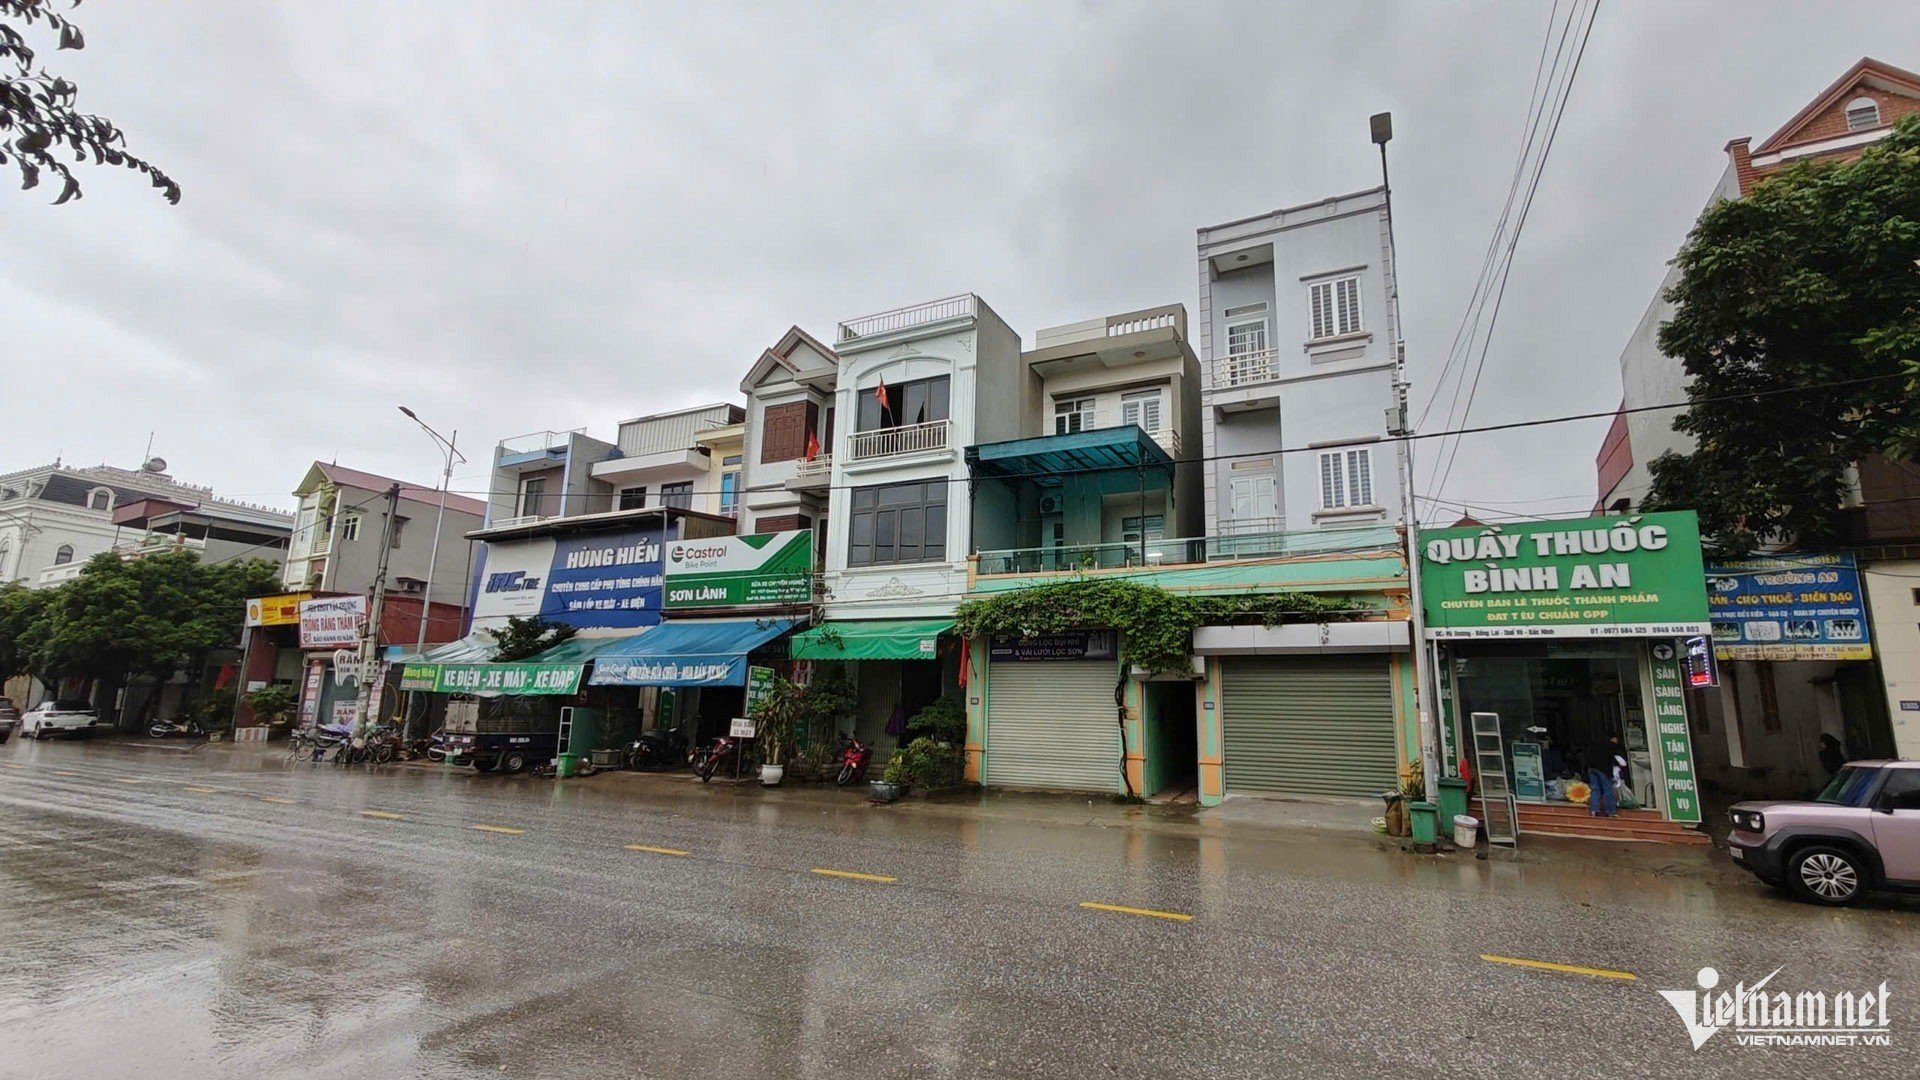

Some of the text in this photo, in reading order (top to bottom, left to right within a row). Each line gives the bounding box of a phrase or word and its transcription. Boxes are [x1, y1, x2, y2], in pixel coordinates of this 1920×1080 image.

[1531, 516, 1668, 556] THUỐC
[567, 537, 661, 569] HÙNG HIỂN
[686, 545, 727, 559] Castrol
[685, 560, 718, 569] Bike Point
[1463, 563, 1631, 593] BÌNH AN
[1817, 571, 1838, 583] AN
[670, 585, 727, 602] SƠN LÀNH
[1736, 595, 1758, 605] CHO
[1829, 592, 1853, 605] ĐẠO
[1441, 596, 1484, 608] CHUYÊN
[1531, 594, 1570, 607] THUỐC
[1538, 608, 1579, 620] CHUẨN
[1583, 610, 1608, 619] GPP
[321, 615, 336, 631] RĂNG
[339, 654, 363, 664] RĂN
[1051, 648, 1066, 657] LỌC
[1067, 647, 1083, 656] SƠN
[444, 669, 456, 686] XE
[457, 667, 481, 691] ĐIỆN
[487, 670, 500, 687] XE
[503, 667, 527, 688] MÁY
[535, 670, 549, 687] XE
[550, 670, 575, 690] ĐẠP
[1656, 685, 1681, 698] SÀNG
[1658, 701, 1683, 716] LẮNG
[1660, 722, 1686, 735] NGHE
[1666, 738, 1685, 755] TẬN
[1668, 778, 1694, 794] PHỤC
[1676, 797, 1690, 812] VỤ
